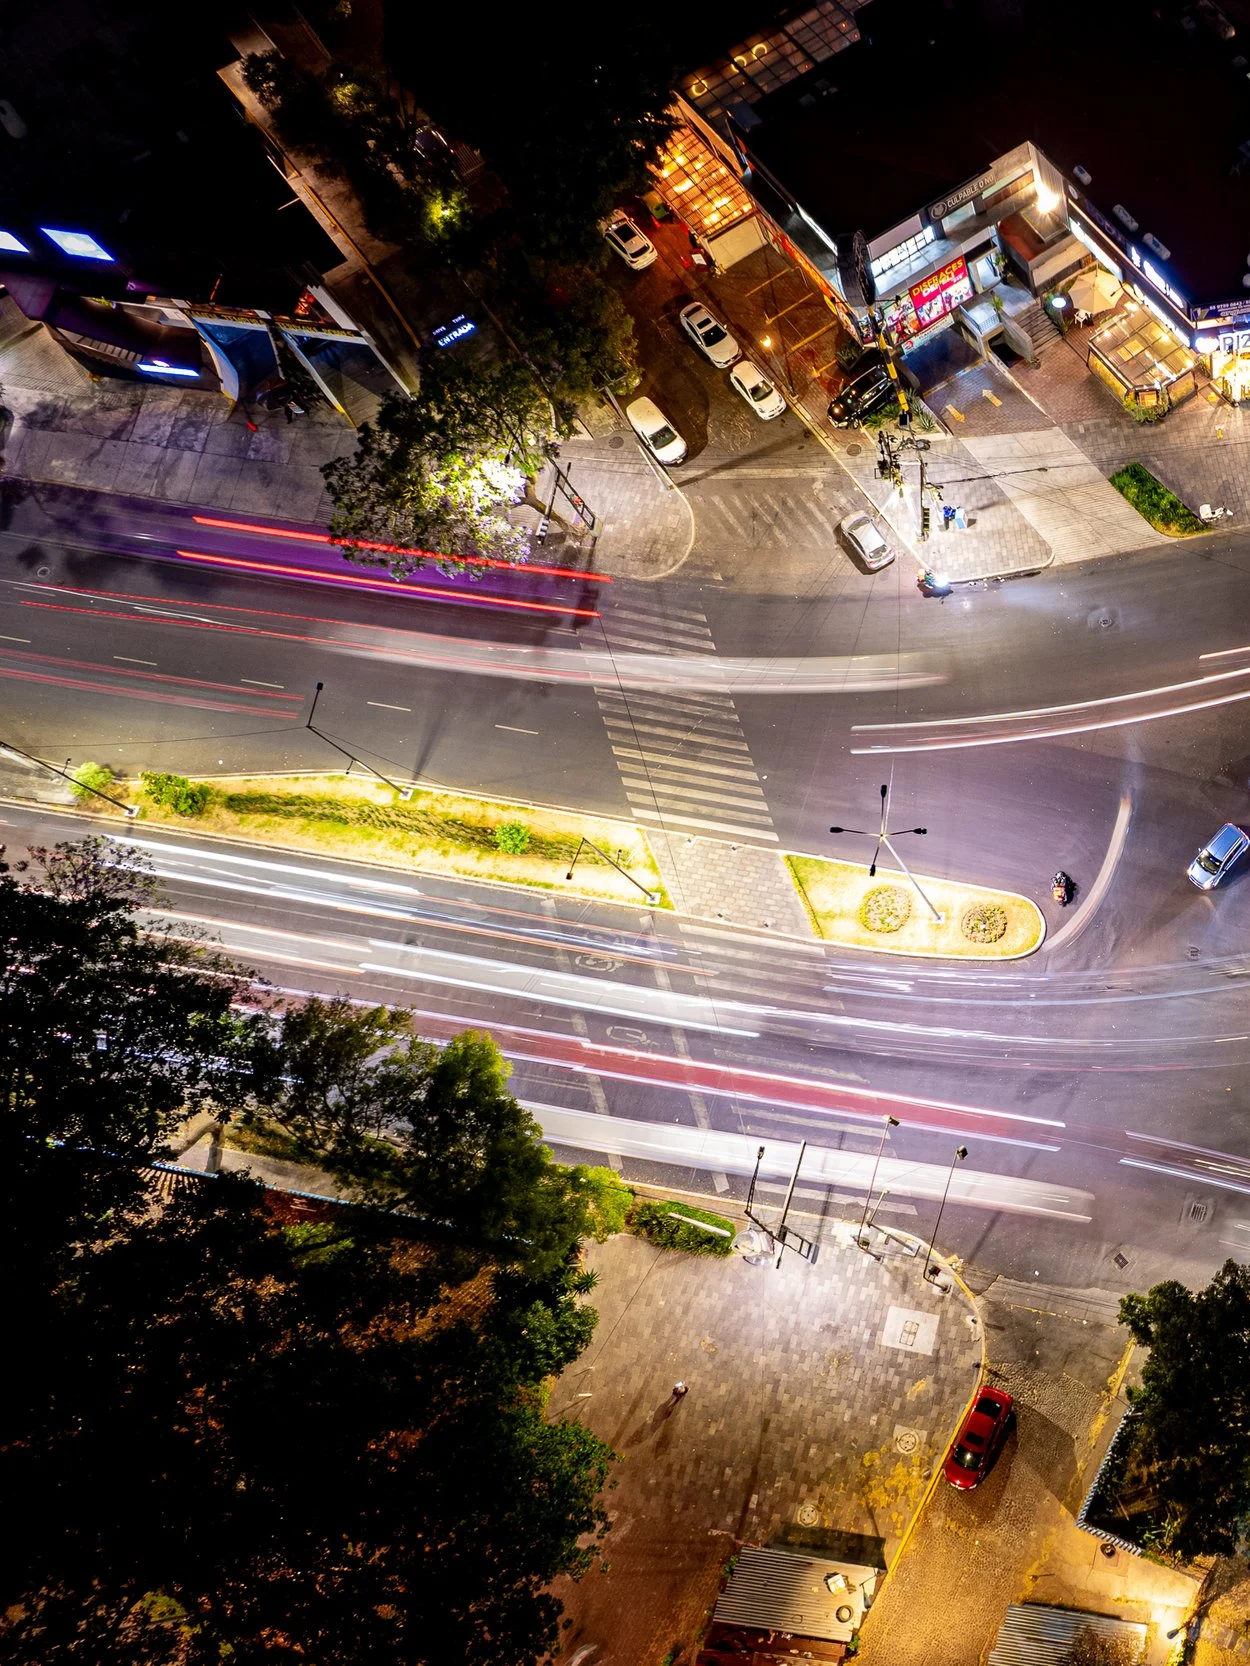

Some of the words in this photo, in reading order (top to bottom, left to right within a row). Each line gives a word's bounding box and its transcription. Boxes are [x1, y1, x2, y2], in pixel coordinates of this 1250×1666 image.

[947, 184, 979, 208] CULPABLE
[984, 174, 995, 186] NO
[912, 259, 964, 297] DISFRACES
[437, 322, 475, 347] ENTRADA
